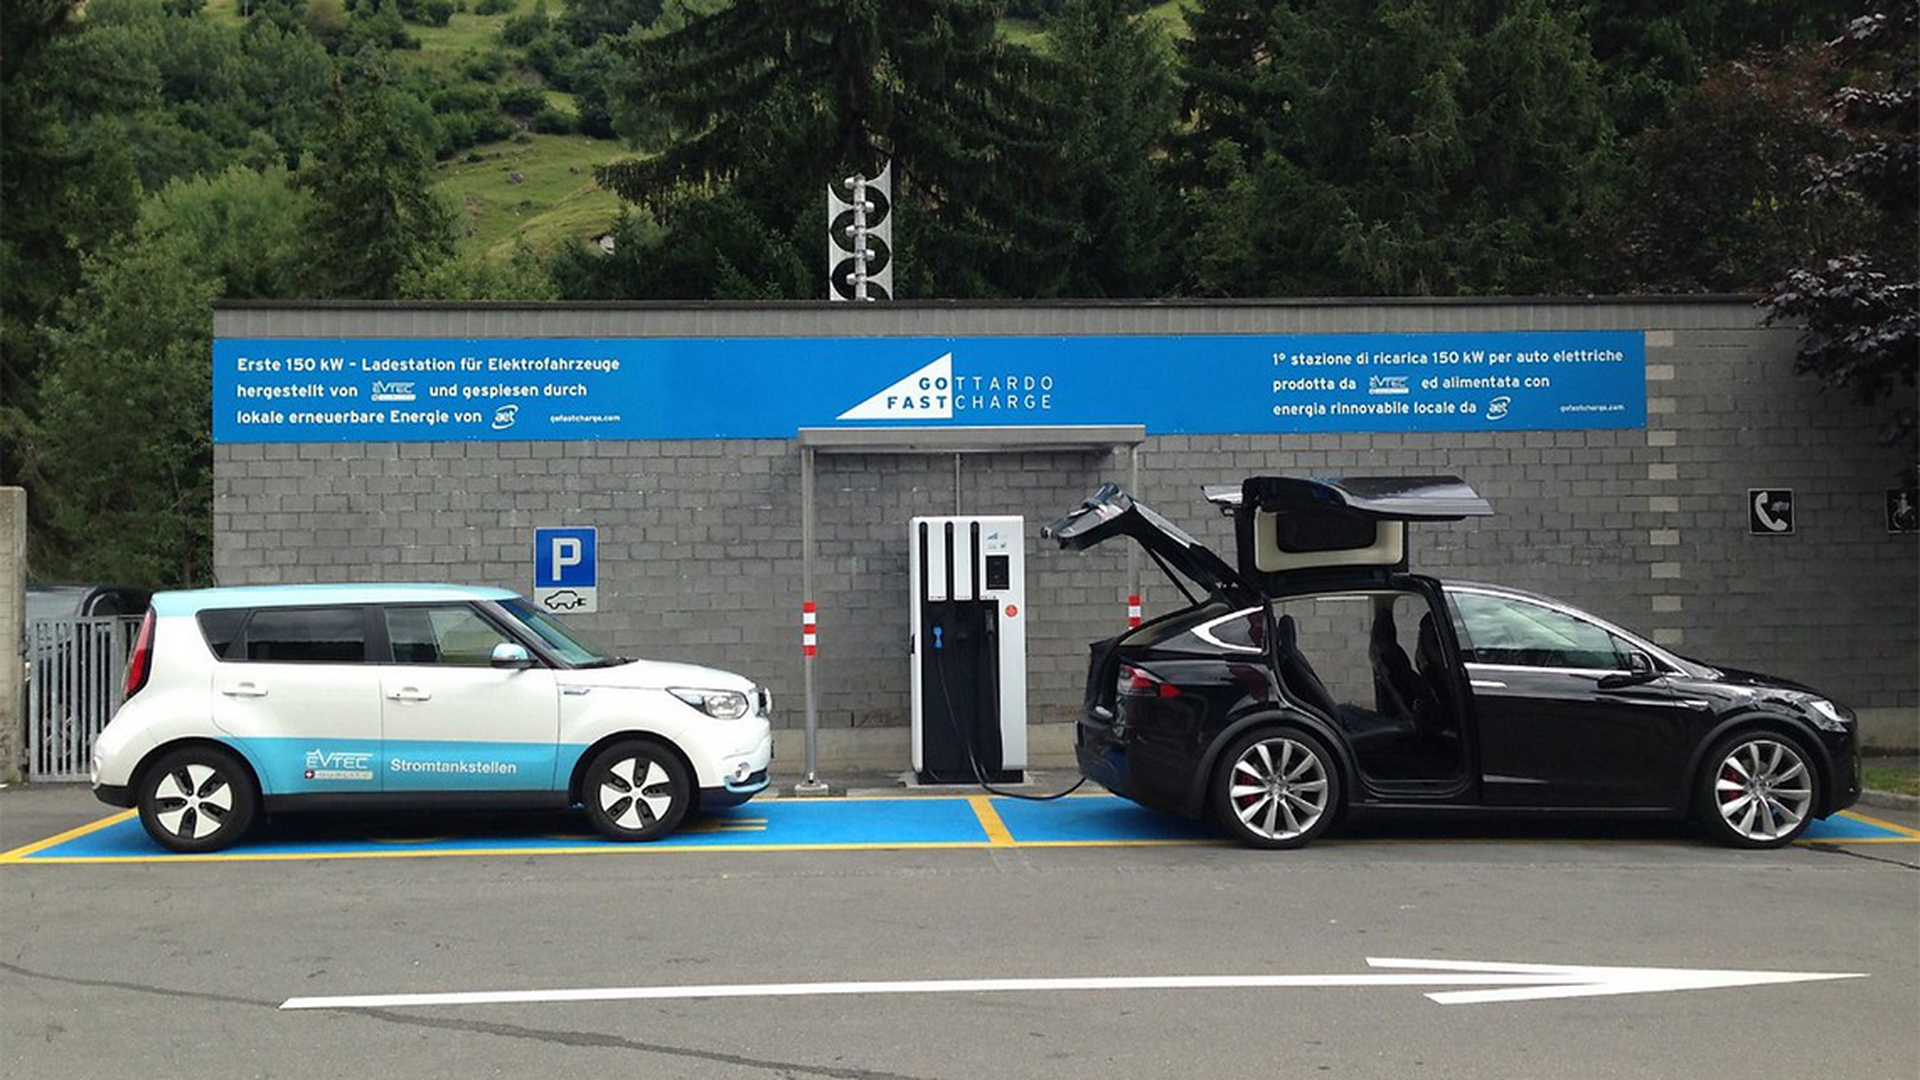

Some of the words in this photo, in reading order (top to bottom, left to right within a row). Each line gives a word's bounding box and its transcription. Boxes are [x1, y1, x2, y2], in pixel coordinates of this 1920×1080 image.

[237, 357, 282, 372] Erste
[286, 357, 317, 372] 150
[320, 357, 345, 372] kW
[361, 357, 456, 372] Ladestation
[460, 357, 484, 372] für
[488, 357, 621, 373] Elektrofahrzeuge
[1290, 353, 1353, 367] stazione
[1356, 351, 1369, 365] di
[1373, 351, 1429, 365] ricarica
[1432, 351, 1460, 365] 150
[1463, 350, 1485, 364] kW
[1488, 353, 1513, 366] per
[1517, 350, 1550, 363] auto
[1553, 349, 1624, 363] elettriche
[237, 383, 325, 400] hergestellt
[330, 386, 359, 398] von
[428, 383, 458, 397] und
[462, 383, 540, 400] gespiesen
[543, 383, 588, 397] durch
[919, 375, 1053, 391] GOTTARDO
[1272, 377, 1336, 393] prodotta
[1339, 376, 1357, 390] da
[1421, 376, 1439, 389] ed
[1443, 375, 1521, 389] alimentata
[1524, 376, 1550, 388] con
[237, 410, 285, 424] lokale
[289, 409, 386, 424] erneuerbare
[390, 409, 450, 426] Energie
[454, 411, 483, 423] von
[1272, 401, 1327, 418] energia
[1331, 400, 1410, 415] rinnovabile
[1413, 401, 1456, 414] locale
[1460, 400, 1477, 414] da
[552, 537, 582, 581] P
[305, 748, 373, 769] EVTEC
[390, 757, 517, 774] Stromtankstellen
